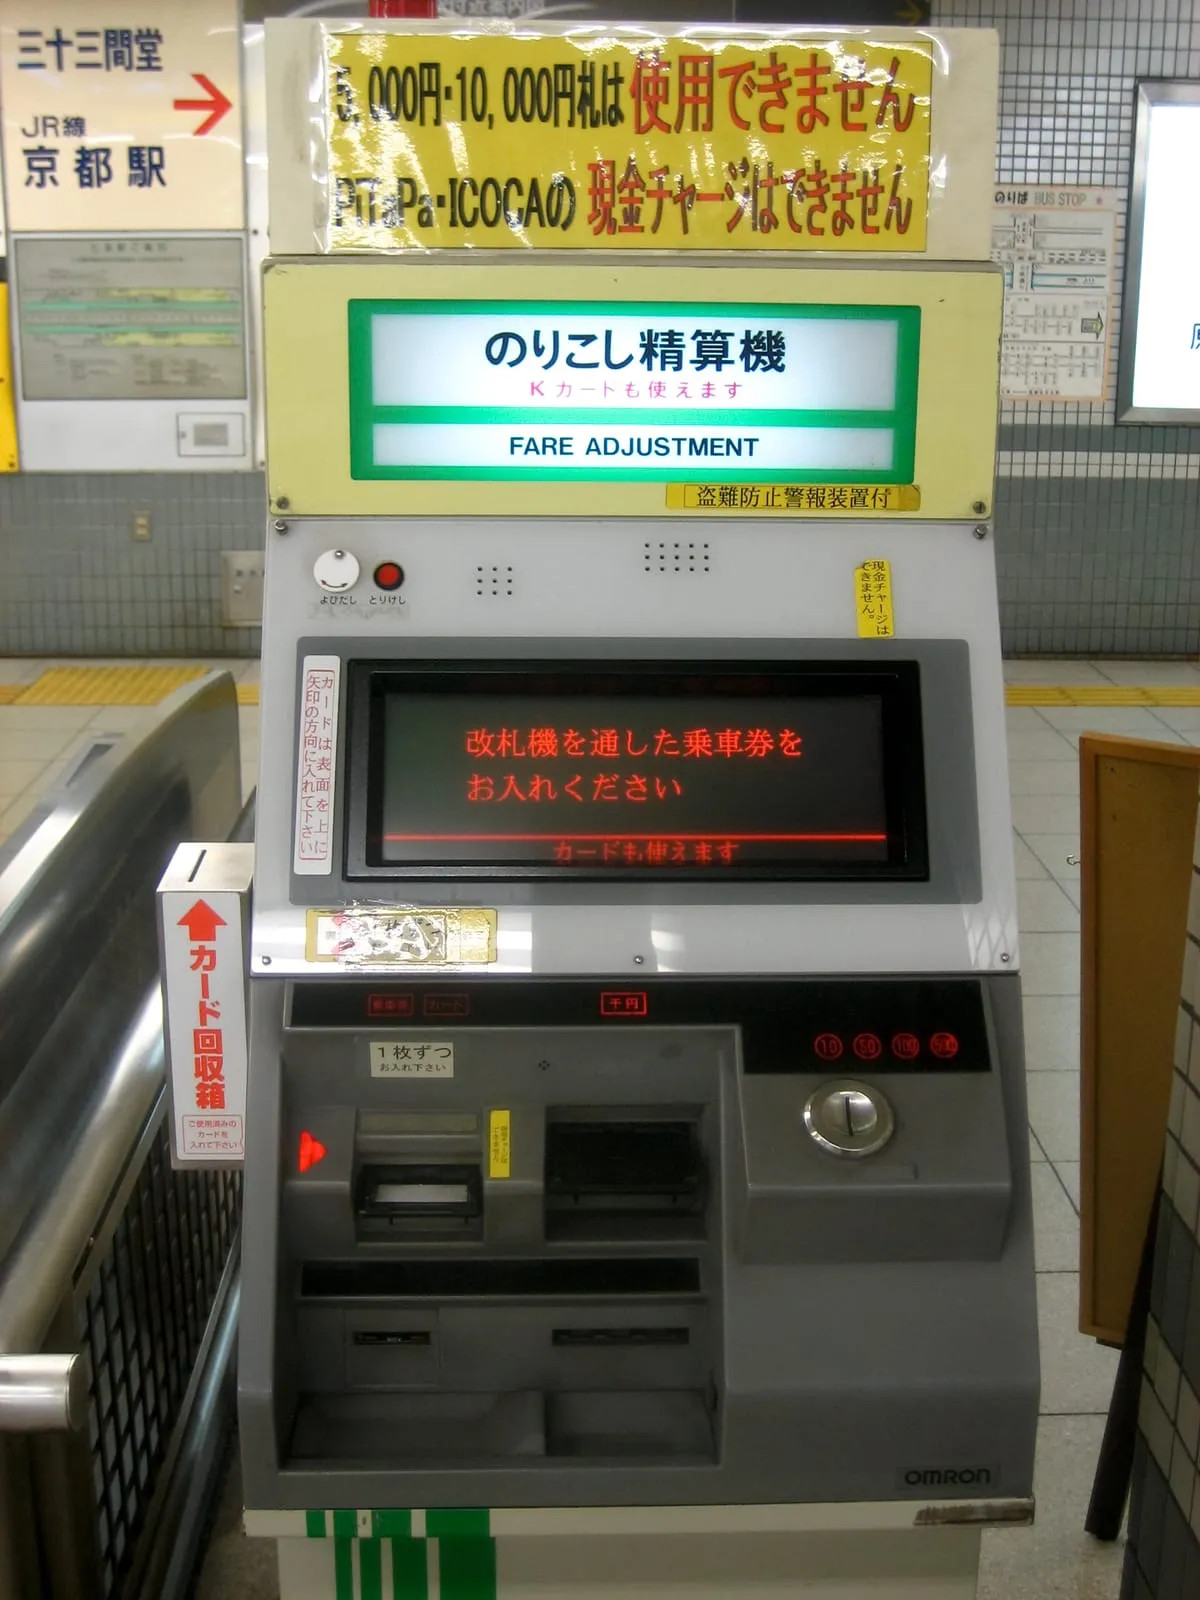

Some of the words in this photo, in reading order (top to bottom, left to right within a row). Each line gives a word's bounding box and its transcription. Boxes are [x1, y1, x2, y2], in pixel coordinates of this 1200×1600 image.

[18, 28, 163, 72] 三十三間堂
[22, 116, 86, 138] JR線
[22, 145, 167, 189] 京都駅
[1034, 191, 1056, 206] BUS
[1058, 191, 1088, 206] STOP
[485, 329, 786, 373] のりこし精算機
[509, 436, 574, 456] FARE
[585, 437, 759, 457] ADJUSTMENT
[697, 486, 891, 509] 盗難防止警報装置付
[369, 595, 406, 605] とりけし
[465, 728, 803, 758] 改札機を通した乗車券を
[301, 675, 321, 854] 矢印の方向に入れて下さい
[314, 676, 334, 854] カードは表面を上に
[466, 773, 683, 802] お入れください
[553, 841, 740, 862] カードも使えます
[190, 945, 226, 1110] カード回収箱
[377, 1045, 452, 1060] 1枚ずつ
[380, 1063, 447, 1073] お入れ下さい
[904, 1468, 991, 1486] OMRON
